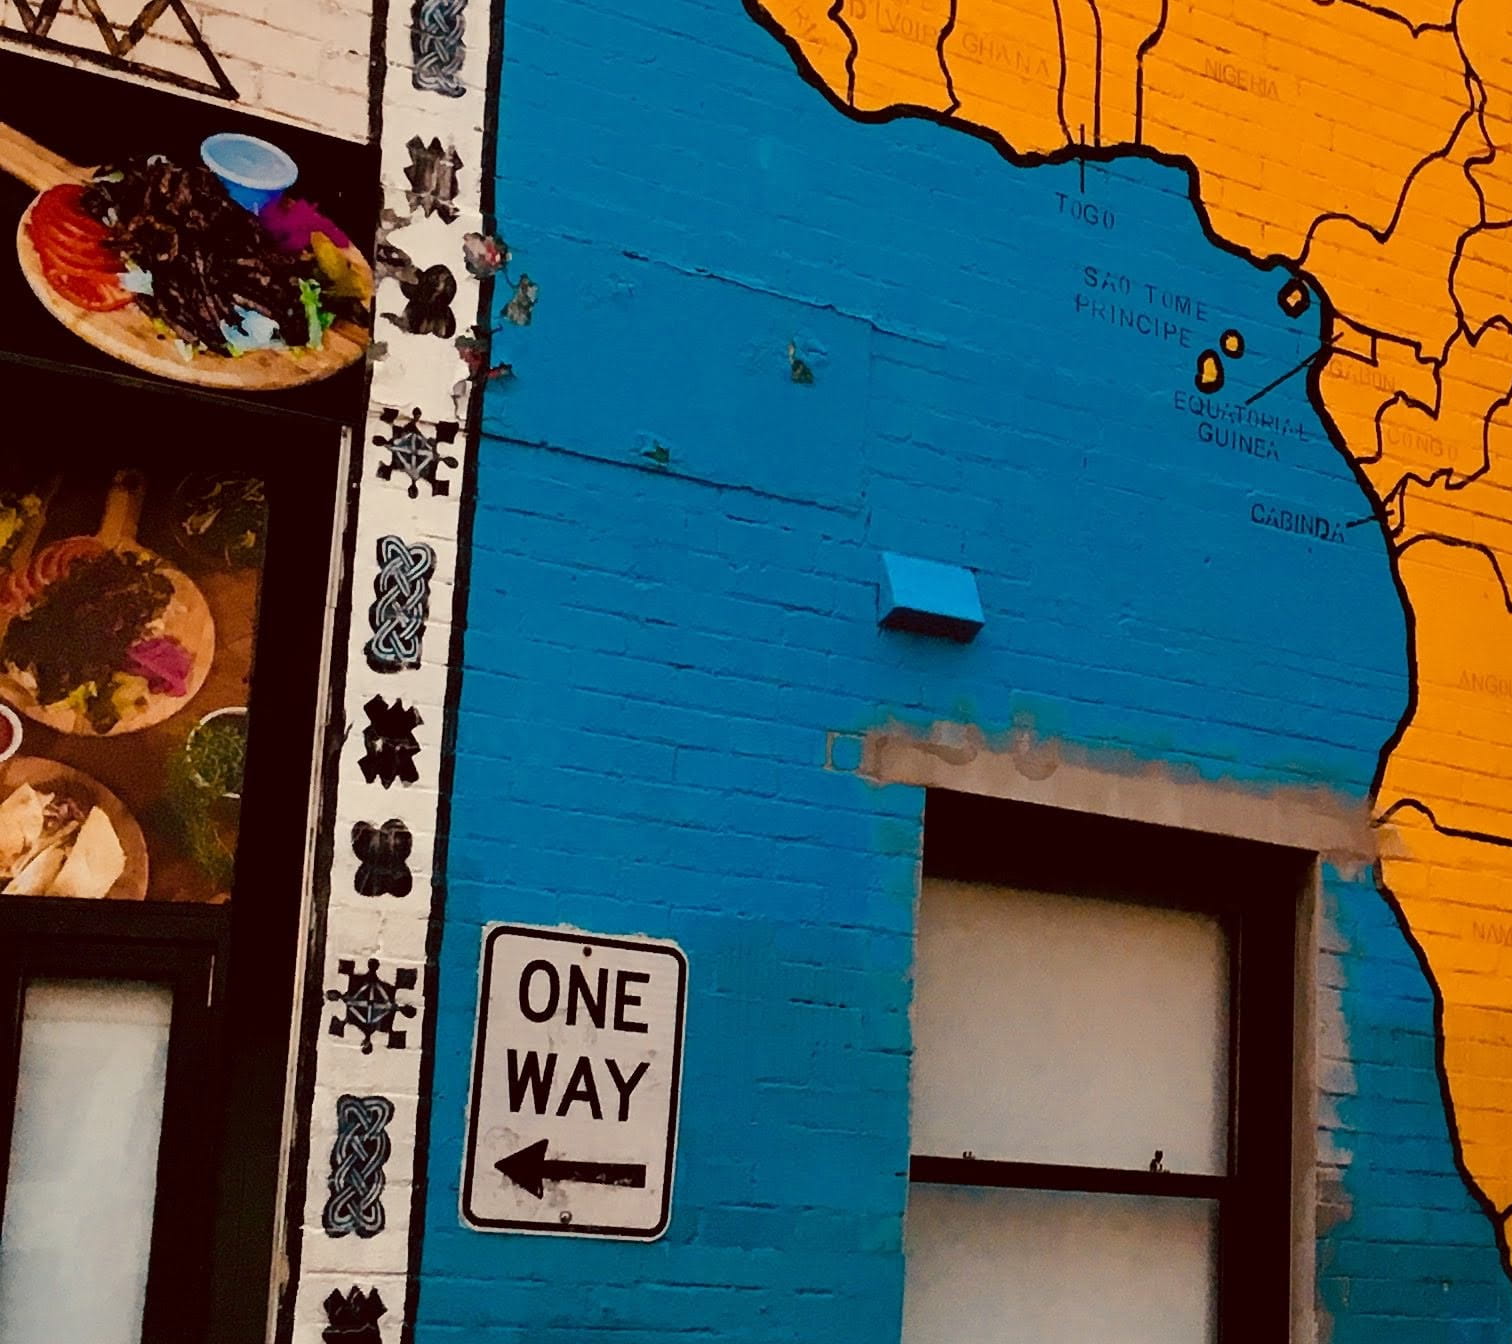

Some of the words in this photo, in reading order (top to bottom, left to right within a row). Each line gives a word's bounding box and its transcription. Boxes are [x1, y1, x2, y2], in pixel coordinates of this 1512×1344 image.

[960, 31, 1051, 80] GHANA
[1203, 56, 1282, 102] NIGERIA
[1054, 192, 1116, 231] TOGO
[1073, 294, 1192, 349] PRINCIPE
[1145, 283, 1209, 323] TOME
[1174, 390, 1310, 444] EQUATORIAL
[1197, 422, 1281, 462] GUINEA
[1250, 503, 1348, 544] CABINDA
[518, 958, 651, 1034] ONE
[506, 1048, 651, 1123] WAY
